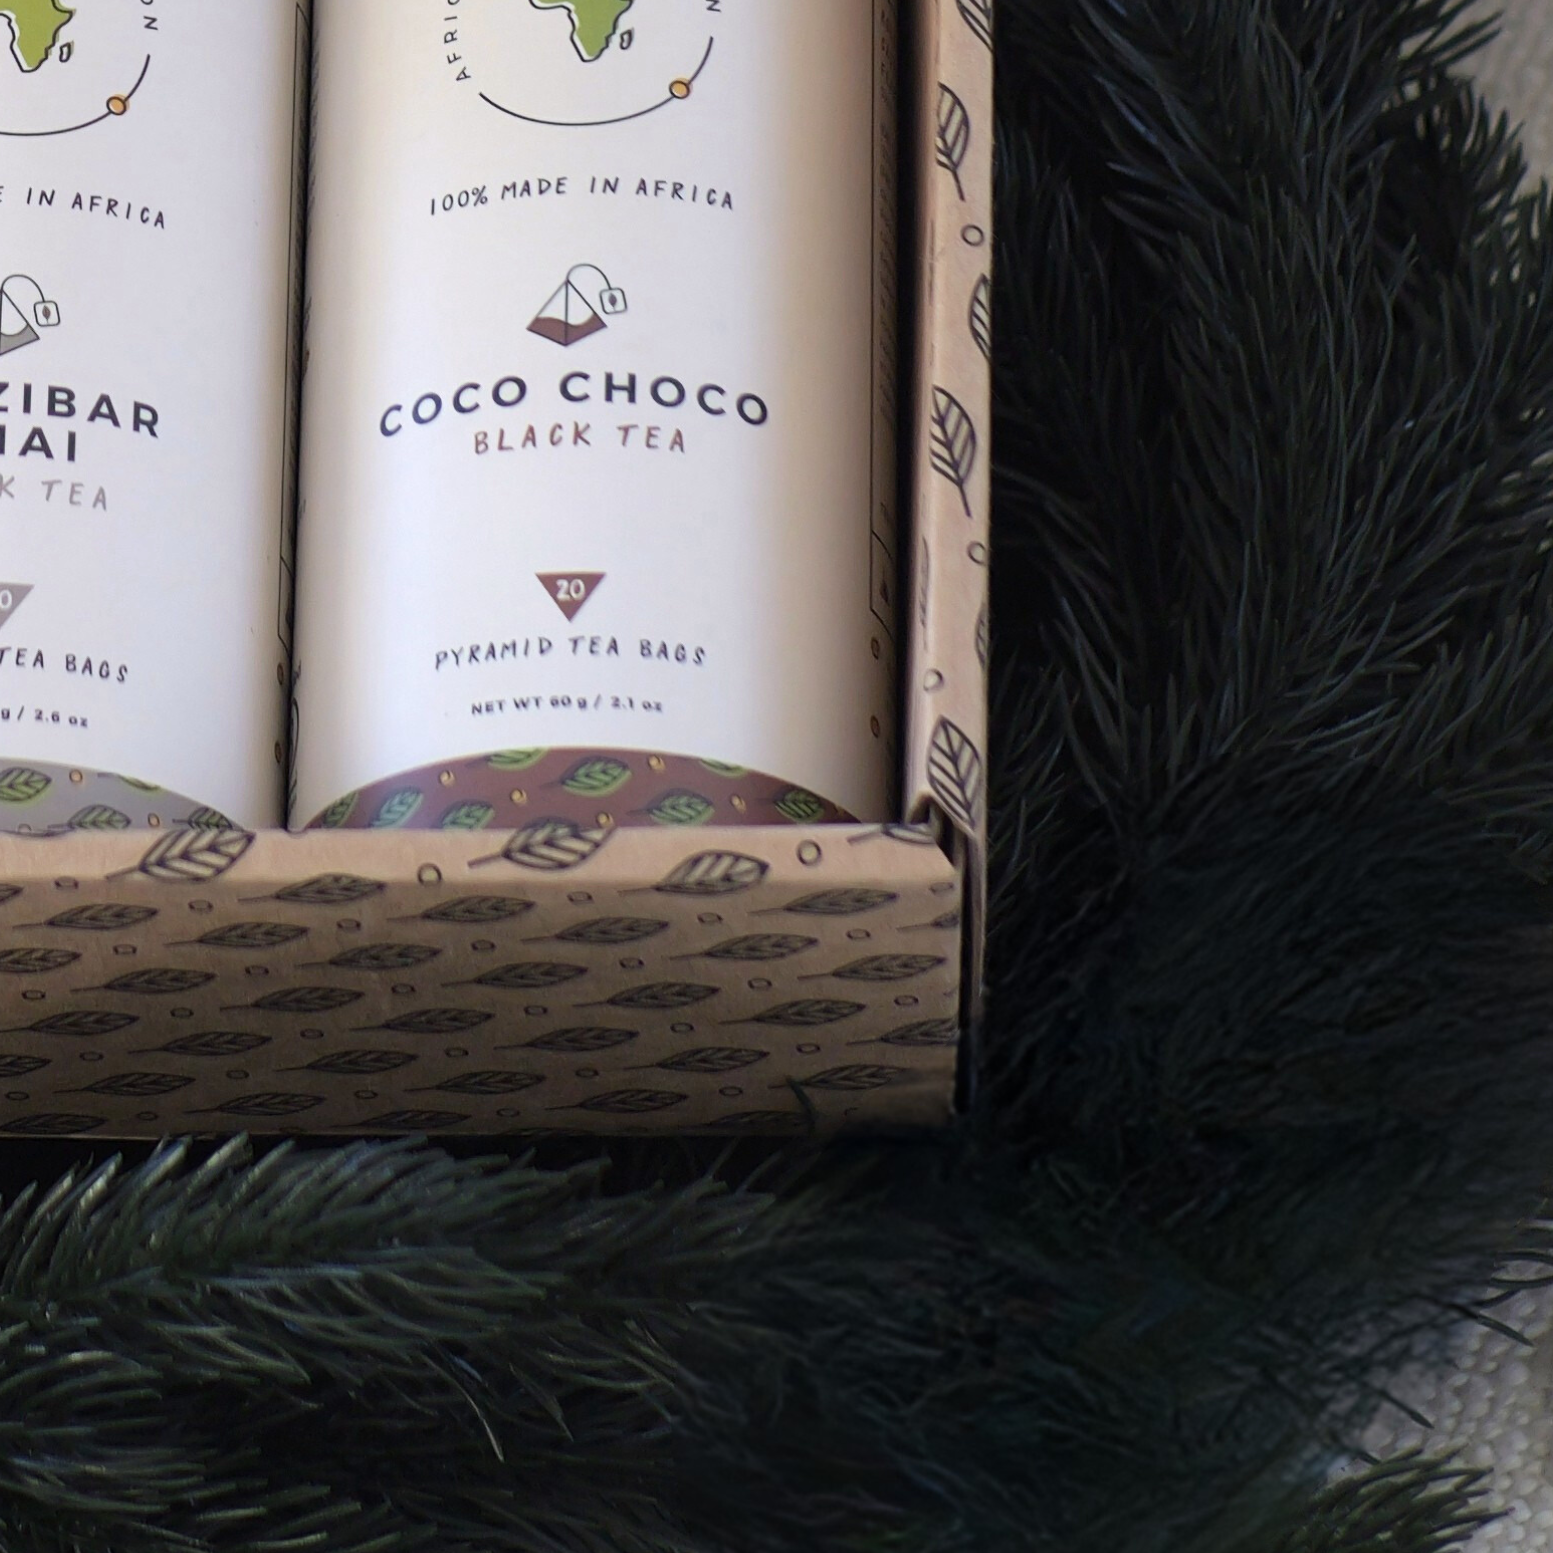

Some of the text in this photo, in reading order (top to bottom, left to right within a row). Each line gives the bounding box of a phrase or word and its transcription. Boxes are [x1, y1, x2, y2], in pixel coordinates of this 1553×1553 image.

[27, 187, 55, 206] IN
[71, 192, 164, 230] AFRICA
[431, 176, 733, 216] 100% MADE IN AFRICA
[380, 371, 768, 437] COCO CHOCO
[474, 421, 685, 455] BLACK TEA
[41, 480, 106, 511] TEA
[556, 580, 584, 600] 20
[65, 654, 128, 684] BAGS
[435, 636, 705, 671] PYRAMID TEA BAGS
[1, 708, 10, 722] g
[17, 705, 24, 721] /
[35, 709, 60, 724] 2.6
[471, 700, 505, 716] NET
[513, 696, 542, 711] WT
[593, 694, 601, 710] /
[611, 696, 634, 710] 2.1
